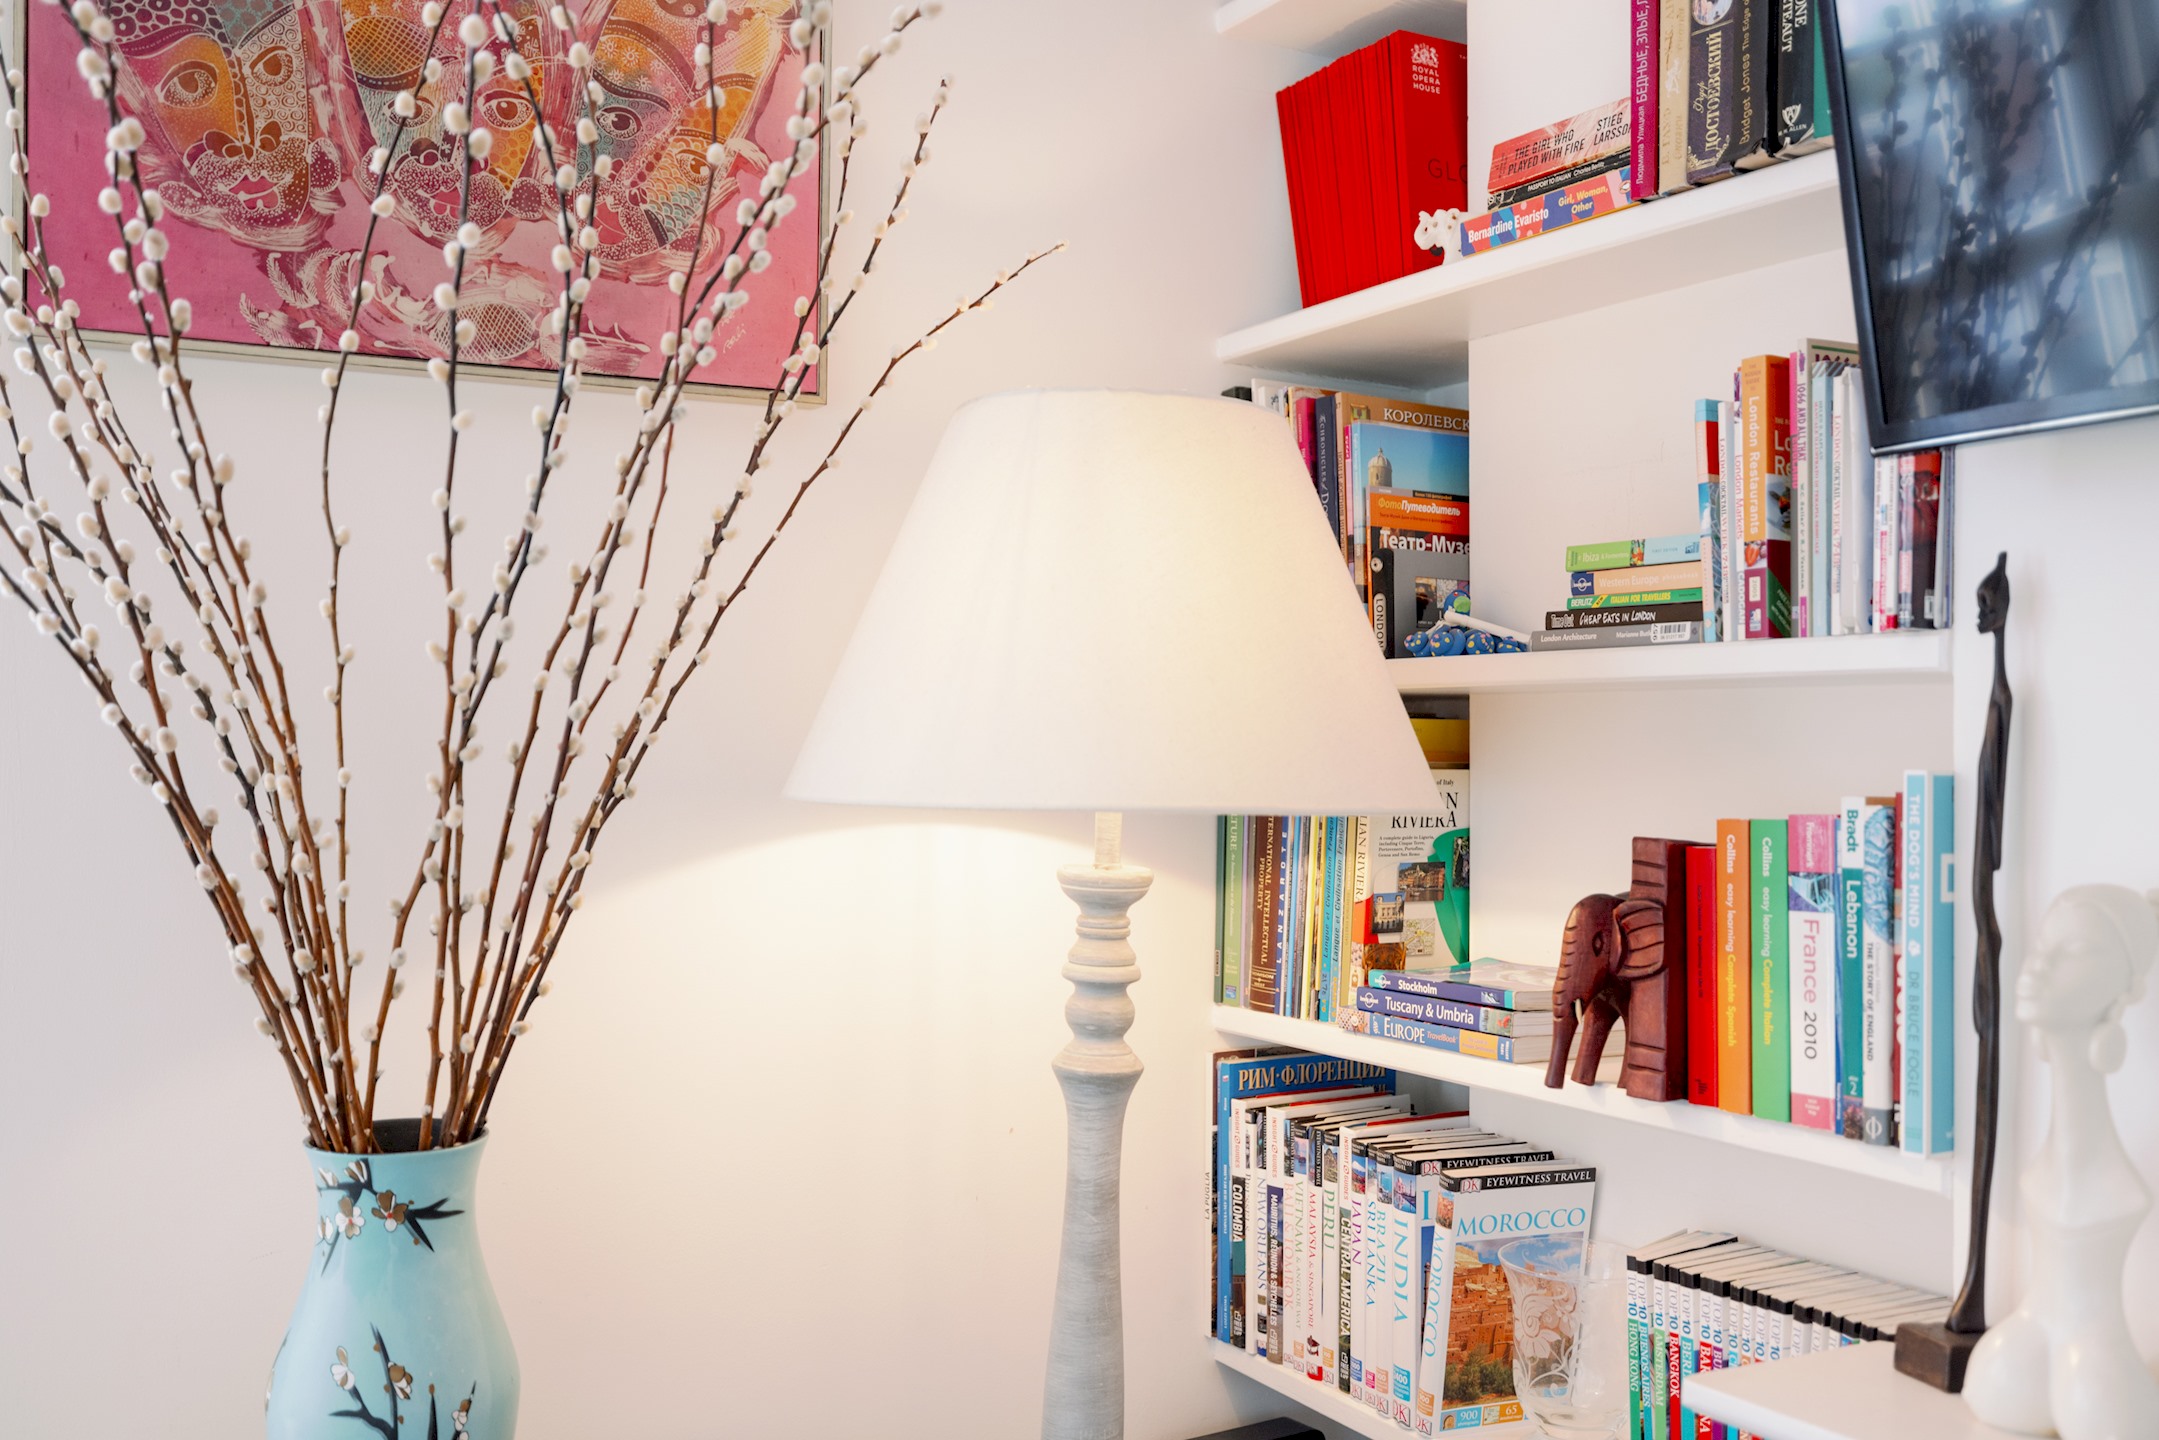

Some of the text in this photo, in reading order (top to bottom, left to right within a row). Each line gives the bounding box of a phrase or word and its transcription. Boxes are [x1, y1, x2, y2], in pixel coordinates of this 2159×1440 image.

[1742, 8, 1751, 31] Edge
[1412, 64, 1439, 77] ROYAL
[1412, 73, 1440, 85] OPERA
[1413, 82, 1440, 94] HOUSE
[1705, 30, 1722, 152] ДОСТОЕВСКИЙ
[1741, 53, 1750, 93] Jones
[1636, 4, 1649, 185] Людмила Улицкая БЕДНЫЕ, ЗЛЫЕ,
[1594, 122, 1631, 146] LARSSO
[1597, 112, 1623, 131] STIEG
[1739, 97, 1752, 145] Bridget
[1508, 138, 1585, 175] PLAYED WITH FIRE
[1515, 129, 1574, 160] THE GIRL WHO
[1558, 185, 1608, 207] Girl, Woman,
[1571, 201, 1593, 214] Other
[1468, 208, 1549, 243] Bernardine Evaristo
[1749, 396, 1759, 447] London
[1797, 383, 1807, 461] 1066 AND ALL THAT
[1319, 423, 1327, 482] CHRONICLES
[1378, 497, 1460, 516] ФотоПутеводитель
[1749, 451, 1761, 535] Restaurants
[1736, 498, 1744, 540] Markets
[1833, 501, 1841, 536] WEEK
[1582, 552, 1600, 562] Ibiza
[1571, 598, 1593, 607] BERLITZ
[1599, 577, 1630, 587] Western
[1631, 575, 1660, 587] Europe
[1610, 591, 1671, 604] ITALIAN FOR TRAVELLERS
[1737, 570, 1745, 626] CADOGAN
[1376, 598, 1385, 650] LONDON
[1540, 632, 1597, 643] London Architecture
[1579, 610, 1657, 625] CHEAP EATS IN LONDON
[1616, 630, 1639, 638] Marianne
[1443, 779, 1454, 787] Italy
[1846, 809, 1859, 852] Bradt
[1356, 851, 1366, 904] RIVIERA
[1908, 794, 1920, 927] THE DOG'S MIND
[1257, 857, 1265, 912] PROPERTY
[1276, 831, 1287, 964] LANZAROTE
[1261, 889, 1271, 965] INTELLECTUAL
[1726, 834, 1738, 1047] Collins easy learning Complete Spanish
[1761, 836, 1773, 1045] Collins easy learning Complete Italian
[1845, 880, 1860, 959] Lebanon
[1398, 978, 1438, 995] Stockholm
[1804, 919, 1820, 1060] France 2010
[1866, 942, 1875, 1061] THE STORY OF ENGLAND
[1384, 1017, 1458, 1044] EUROPE TravelBook
[1385, 996, 1475, 1025] Tuscany & Umbria
[1907, 971, 1919, 1098] DR BRUCE FOGLE
[1422, 1161, 1440, 1175] DK
[1461, 1178, 1481, 1192] DK
[1486, 1172, 1551, 1187] EYEWITNESS
[1554, 1170, 1591, 1182] TRAVEL
[1232, 1184, 1243, 1243] COLOMBIA
[1257, 1177, 1266, 1215] NEW
[1270, 1194, 1278, 1237] MAURITIUS,
[1295, 1180, 1304, 1253] VIETNAM
[1366, 1201, 1376, 1230] SRI
[1284, 1221, 1294, 1232] &
[1308, 1192, 1316, 1258] MALAYSIA
[1324, 1189, 1335, 1250] PERU
[1352, 1199, 1362, 1265] JAPAN
[1456, 1207, 1586, 1237] MOROCCO
[1270, 1239, 1278, 1273] RÉUNION
[1340, 1217, 1351, 1336] CENTRAL AMERICA
[1394, 1218, 1409, 1321] INDIA
[1270, 1280, 1278, 1326] SEYCHELLES
[1424, 1231, 1446, 1358] MOROCCO
[1682, 1292, 1691, 1334] TOP 10
[1628, 1276, 1639, 1392] TOP 10 HONG KONG
[1701, 1295, 1710, 1339] TOP 10
[1770, 1317, 1781, 1360] TOP 10
[1637, 1279, 1651, 1407] TOP 10 BUENOS AIRES
[1654, 1285, 1664, 1406] TOP 10 AMSTERDAM
[1669, 1287, 1680, 1398] TOP 10 BANGKOK
[1460, 1409, 1478, 1420] 900
[1505, 1404, 1517, 1414] 65
